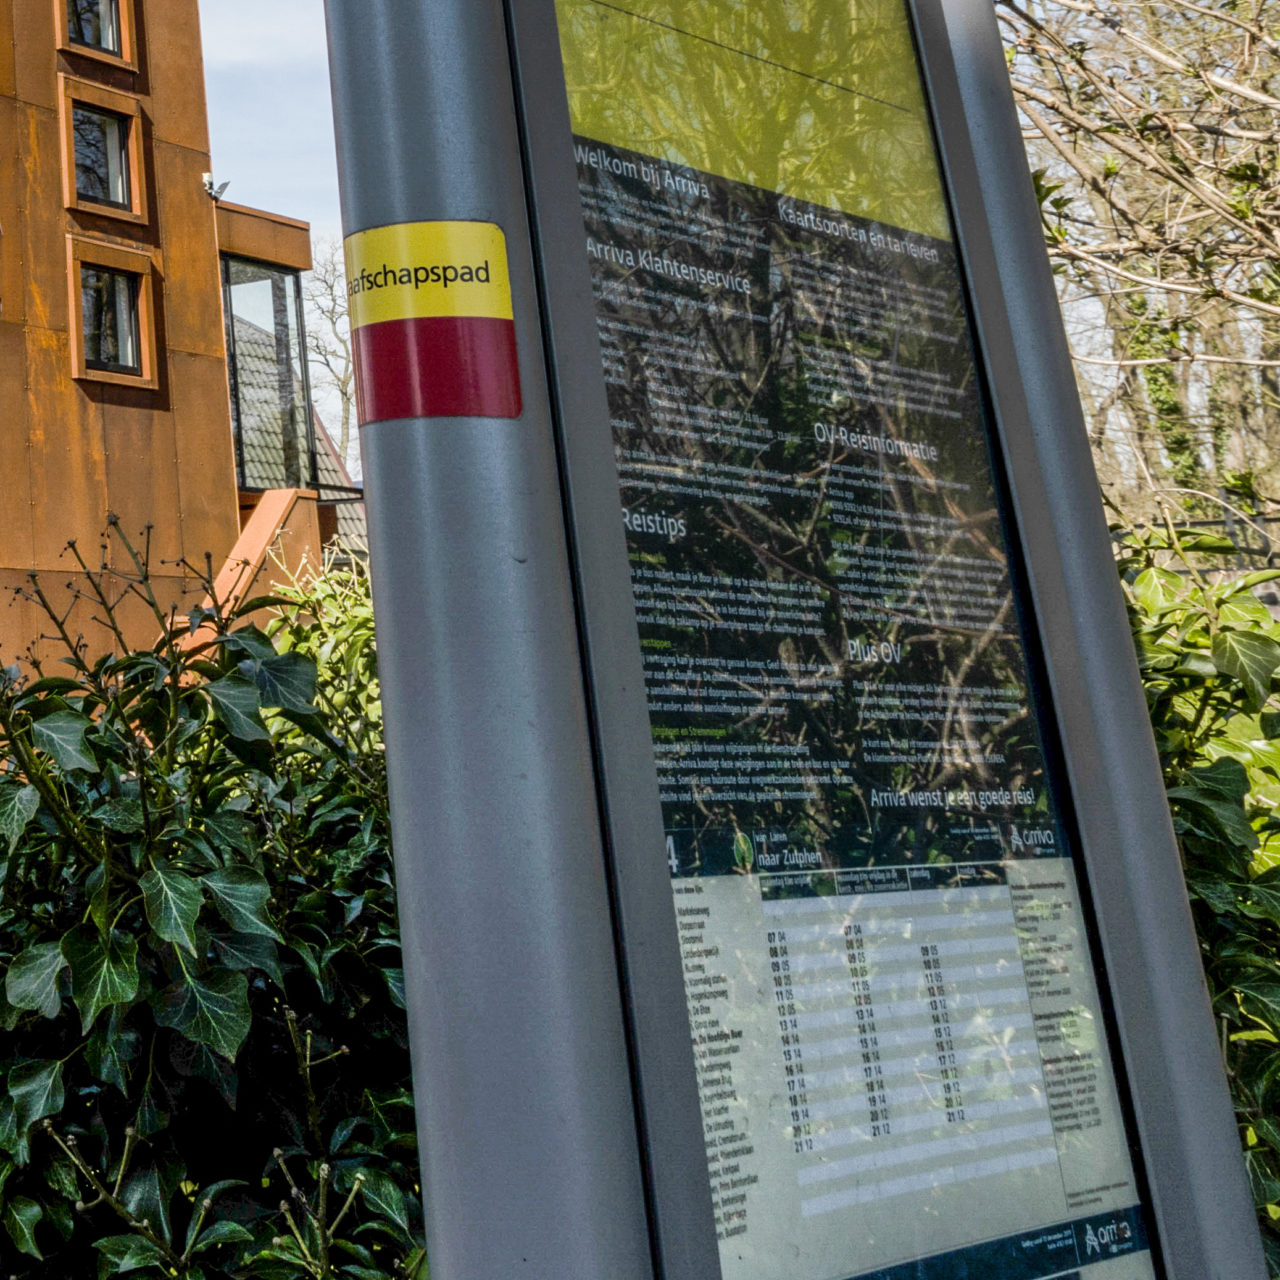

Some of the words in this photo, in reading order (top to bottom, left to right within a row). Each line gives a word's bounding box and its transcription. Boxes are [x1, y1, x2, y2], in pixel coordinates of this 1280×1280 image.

[572, 144, 638, 180] Welkom
[641, 161, 661, 190] bij
[664, 170, 710, 200] Arriva
[778, 202, 868, 244] Kaartsoorten
[869, 231, 885, 249] en
[886, 235, 940, 264] tarieven
[586, 236, 636, 267] Arriva
[638, 249, 752, 295] Klantenservice
[814, 422, 939, 462] OV-Reisinformatie
[621, 507, 687, 542] Reistips
[848, 639, 878, 663] Plus
[880, 641, 902, 664] OV
[871, 786, 907, 807] Arriva
[907, 787, 944, 807] wenst
[943, 788, 955, 810] je
[957, 791, 978, 806] een
[978, 787, 1011, 810] goede
[1012, 787, 1036, 805] reis!
[758, 852, 780, 866] naar
[782, 847, 823, 868] Zutphen
[1098, 1219, 1132, 1244] arria
